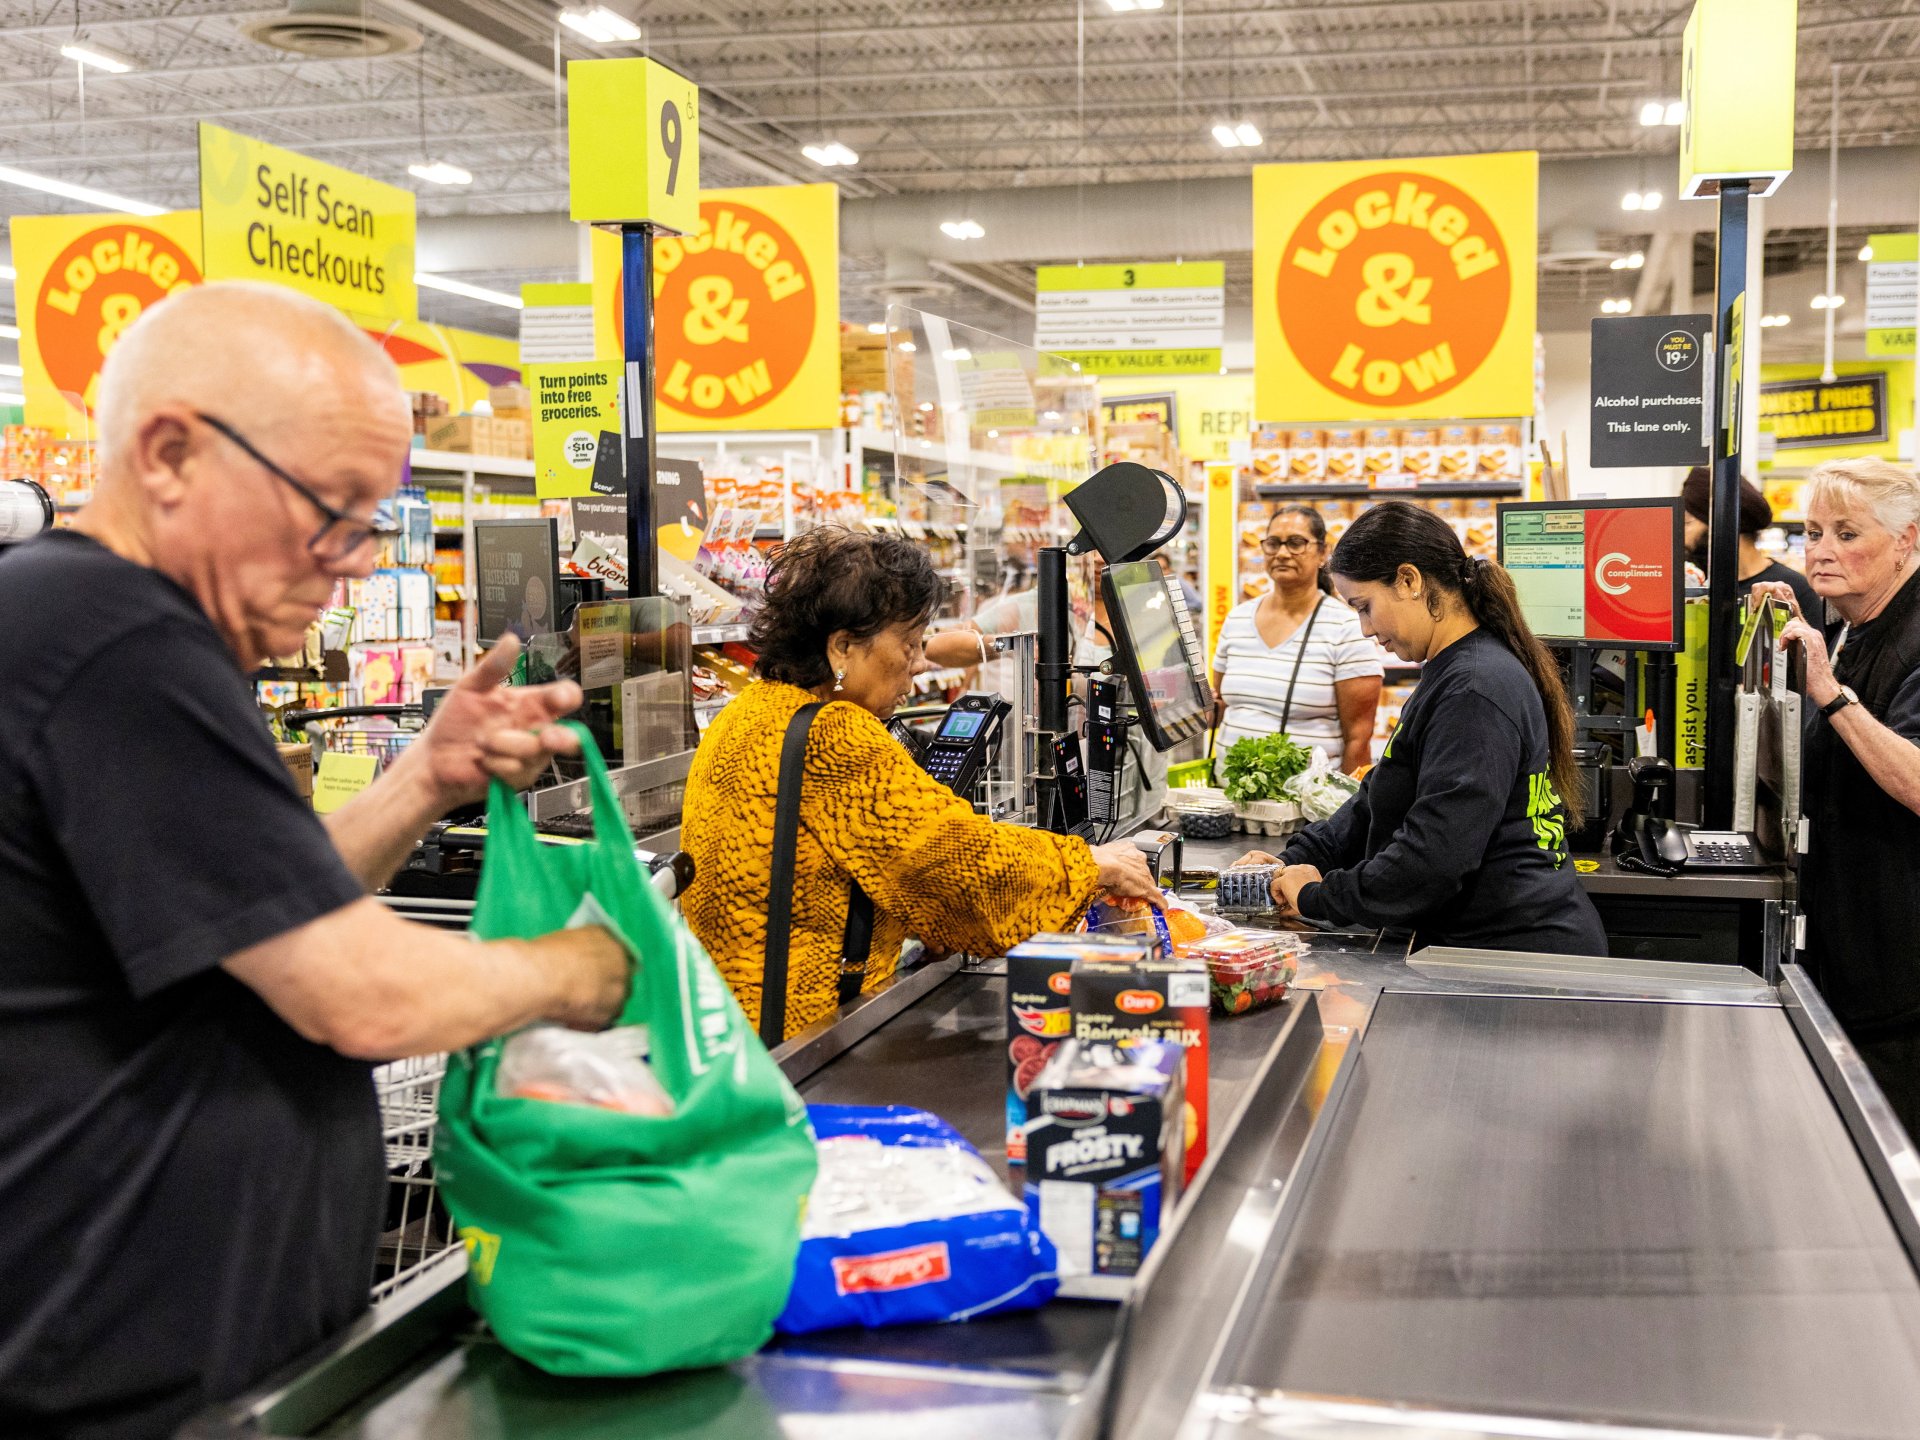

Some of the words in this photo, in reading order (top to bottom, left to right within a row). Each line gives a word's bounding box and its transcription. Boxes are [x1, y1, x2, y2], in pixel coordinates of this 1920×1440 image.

[660, 99, 682, 197] 9
[256, 164, 308, 219] Self
[317, 183, 374, 240] Scan
[247, 221, 385, 294] Checkouts
[650, 210, 806, 302] ocked
[1123, 269, 1136, 286] 3
[1355, 252, 1433, 327] &
[683, 275, 750, 345] &
[1666, 351, 1689, 365] 19+
[540, 375, 566, 389] Turn
[569, 372, 608, 389] points
[541, 391, 565, 404] into
[568, 389, 592, 403] free
[1594, 395, 1639, 407] Alcohol
[1642, 394, 1704, 408] purchases.
[1819, 385, 1875, 410] PRICE
[542, 405, 601, 422] groceries.
[1607, 421, 1631, 433] This
[1634, 421, 1660, 432] lane
[1662, 420, 1691, 433] only.
[573, 442, 594, 452] $10
[1607, 569, 1663, 579] compliments
[1686, 678, 1700, 714] you.
[1682, 717, 1697, 764] assist
[1123, 995, 1155, 1009] Dare
[1046, 1133, 1144, 1173] FROSTY
